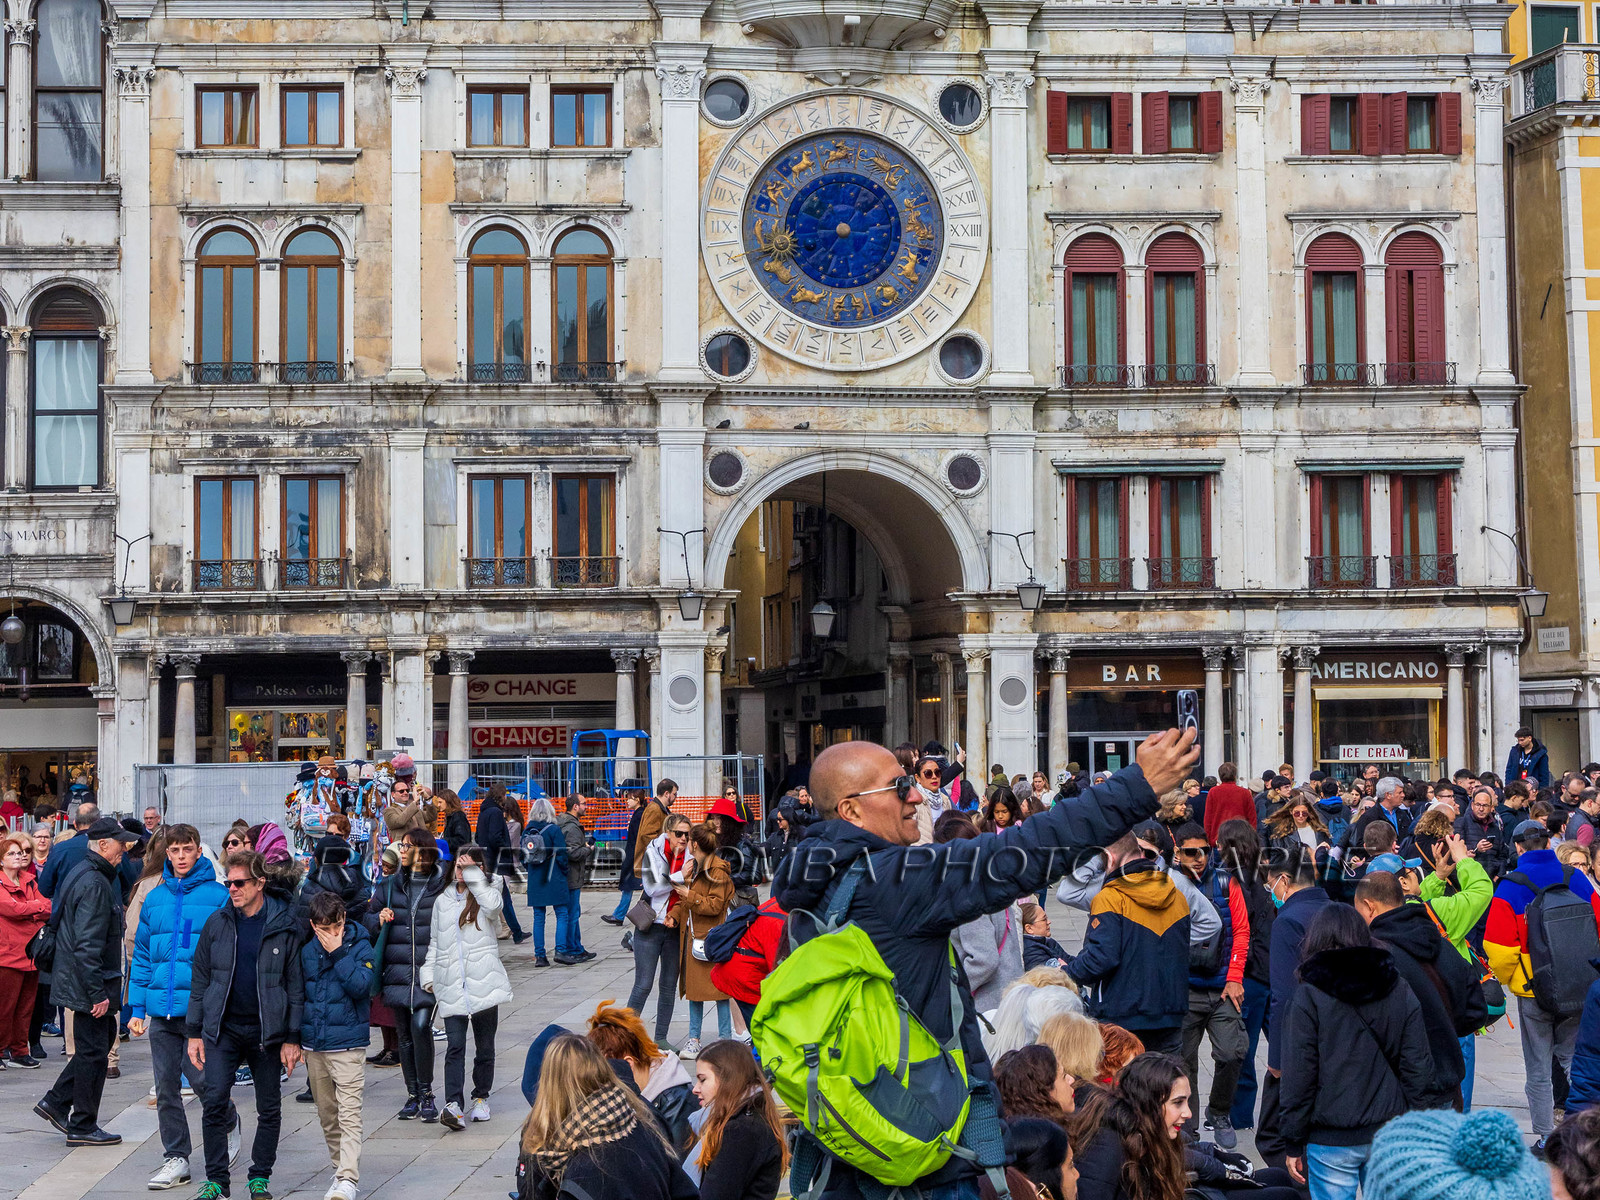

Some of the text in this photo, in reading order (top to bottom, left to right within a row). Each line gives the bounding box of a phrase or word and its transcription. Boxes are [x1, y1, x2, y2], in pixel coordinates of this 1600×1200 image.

[892, 115, 914, 140] XX
[934, 158, 963, 182] XXII
[945, 190, 977, 209] XXIII
[950, 224, 982, 237] XXIIII
[730, 281, 746, 296] X
[944, 283, 959, 299] II
[921, 306, 939, 323] III
[897, 325, 915, 344] IIII
[871, 338, 884, 350] V
[17, 530, 67, 541] MARCO
[1102, 664, 1162, 682] BAR
[1310, 661, 1439, 679] AMERICANO
[255, 684, 347, 696] Palesa Galler
[494, 679, 577, 696] CHANGE
[473, 726, 568, 746] CHANGE
[1342, 747, 1406, 758] ICE CREAM
